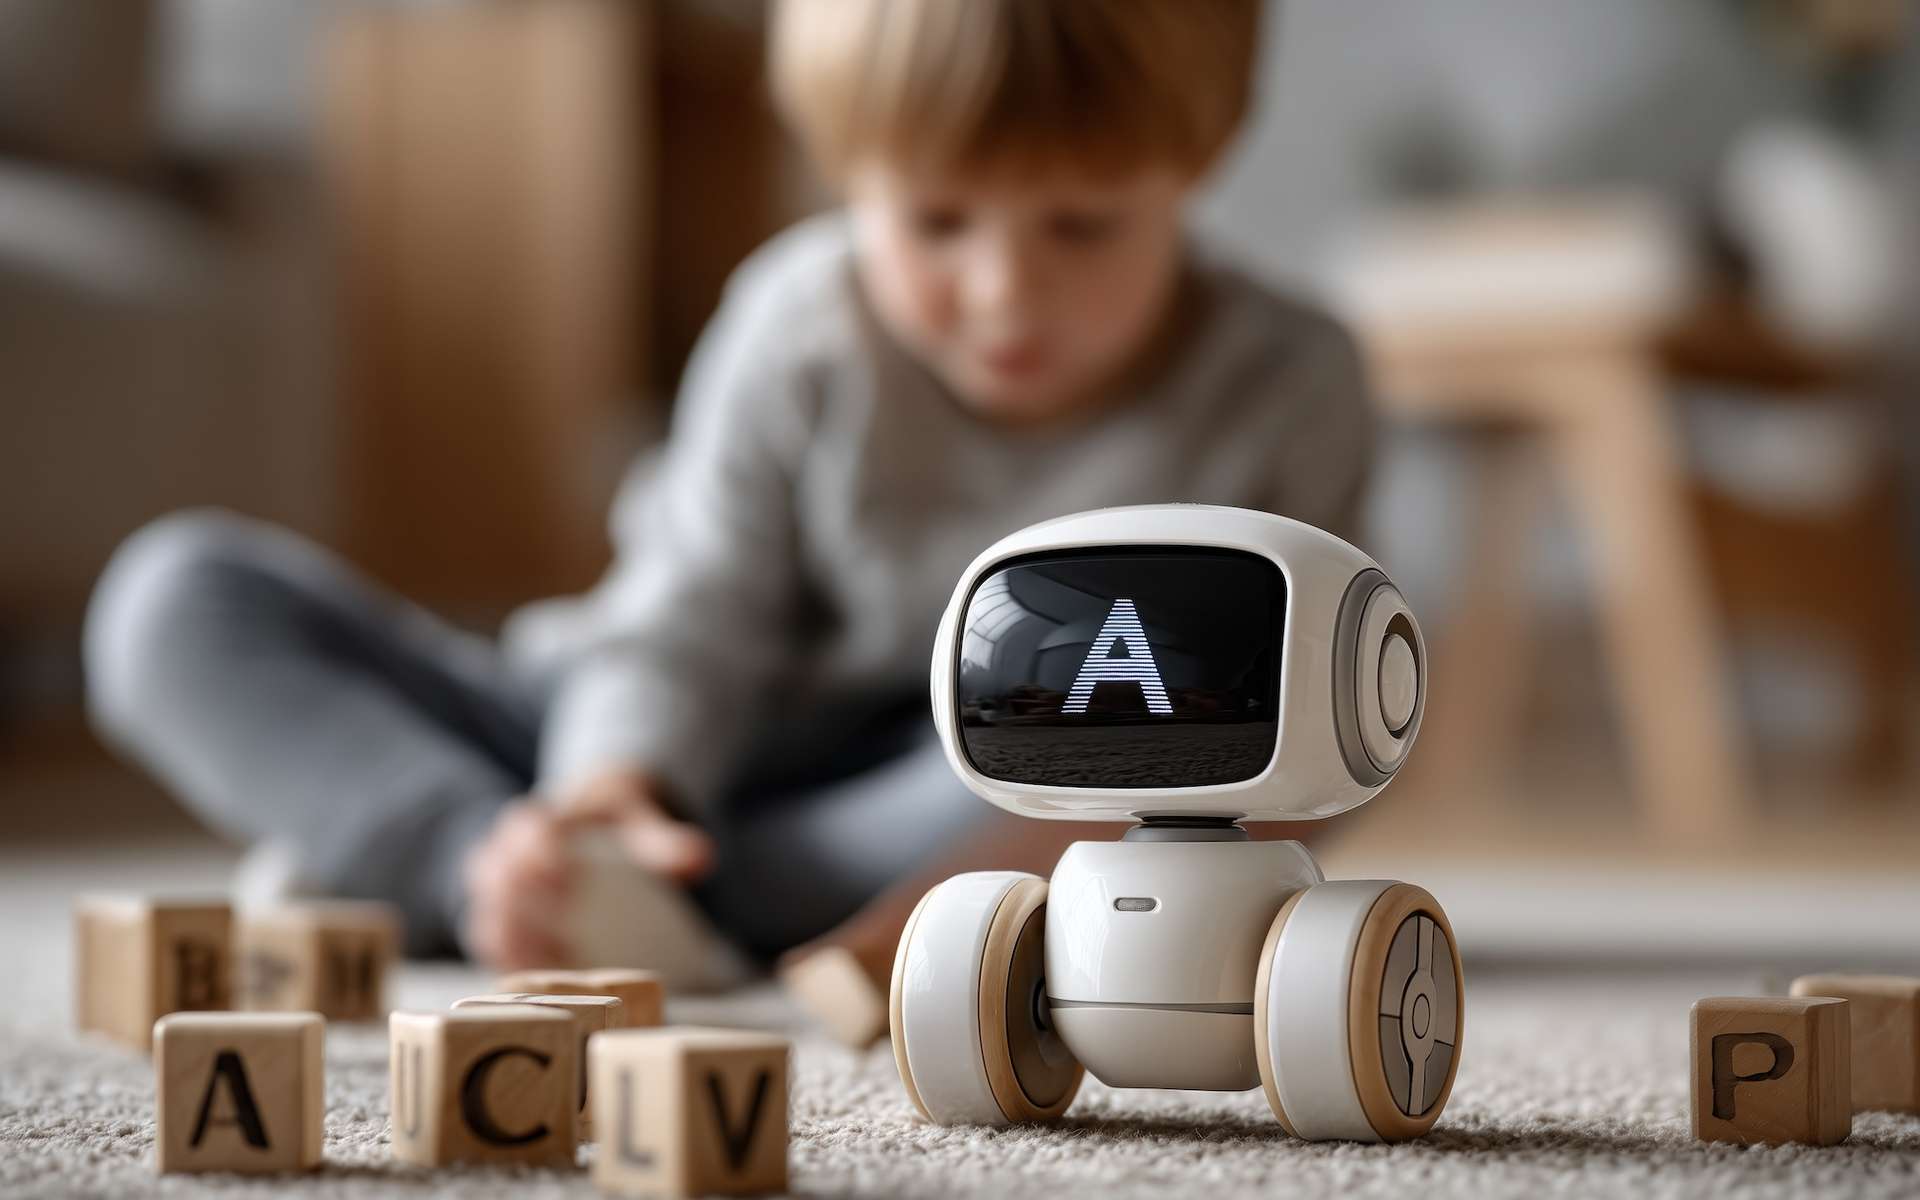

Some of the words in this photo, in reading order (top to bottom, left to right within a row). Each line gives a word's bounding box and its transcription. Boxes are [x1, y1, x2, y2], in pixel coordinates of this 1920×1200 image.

[1060, 599, 1174, 713] A
[189, 1047, 273, 1150] A
[460, 1045, 552, 1147] C
[614, 1065, 654, 1166] L
[704, 1066, 772, 1172] V
[1711, 1031, 1795, 1121] P
